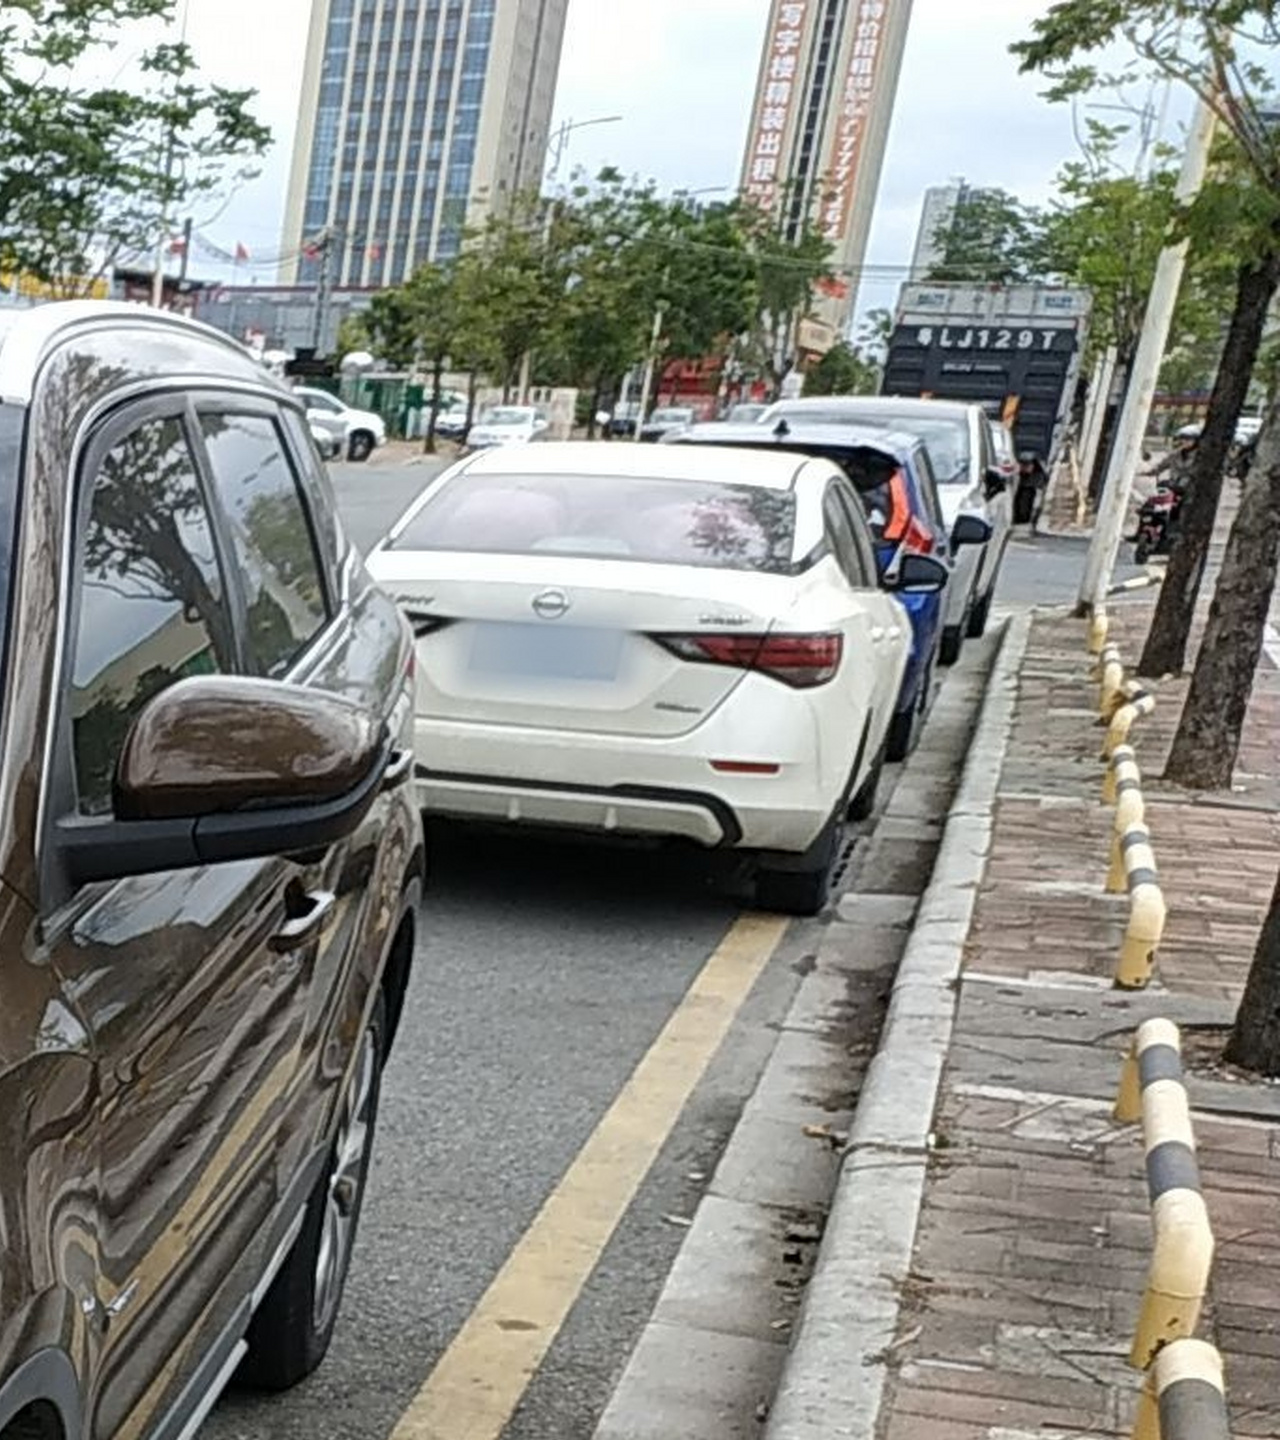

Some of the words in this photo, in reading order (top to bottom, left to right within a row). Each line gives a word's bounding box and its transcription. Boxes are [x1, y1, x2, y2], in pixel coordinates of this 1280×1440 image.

[751, 2, 806, 181] 写字楼精装出租
